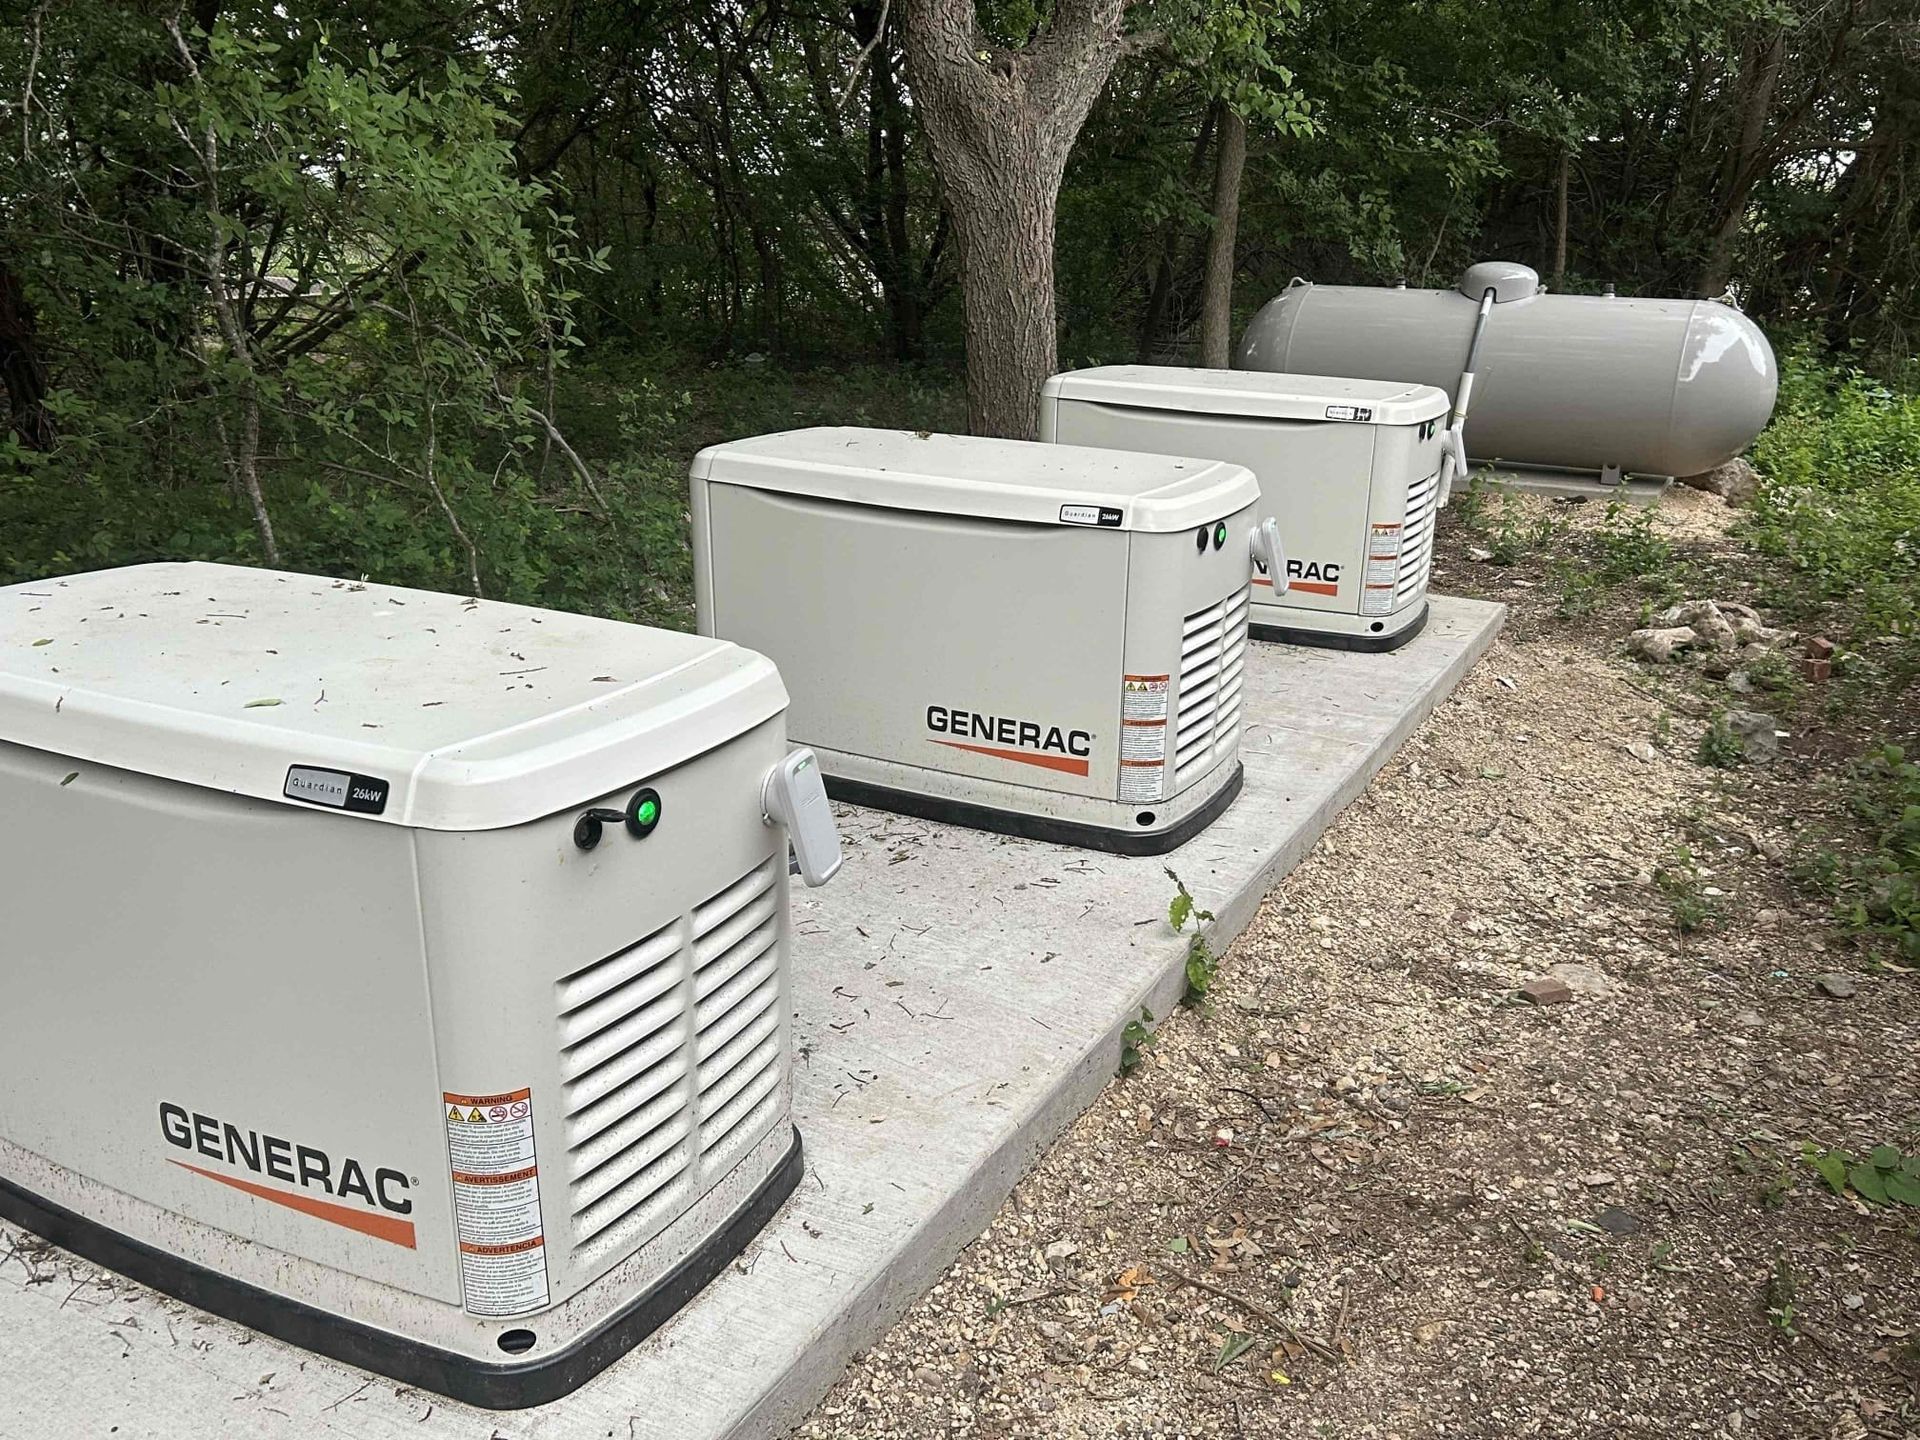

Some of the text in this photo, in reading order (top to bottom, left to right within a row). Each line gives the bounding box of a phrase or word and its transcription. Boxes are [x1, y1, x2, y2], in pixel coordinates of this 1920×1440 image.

[1253, 559, 1339, 582] NRAC
[927, 705, 1091, 756] GENERAC
[292, 777, 382, 802] Guardian 26kW
[470, 1094, 513, 1105] WARNING
[159, 1101, 413, 1215] GENERAC
[464, 1168, 534, 1184] AVERTISSEMENT
[476, 1240, 537, 1254] ADVERTENCIA
